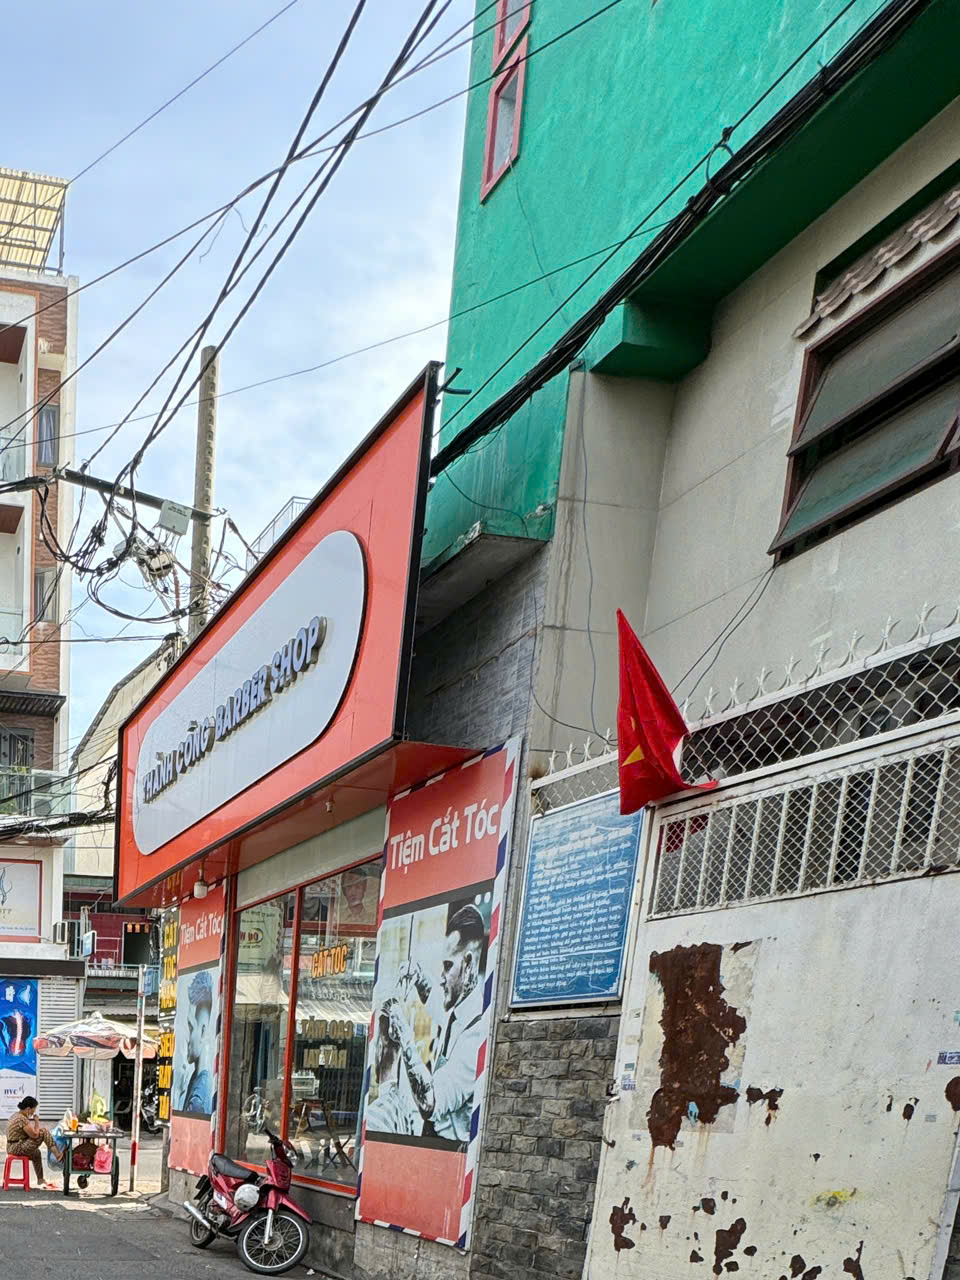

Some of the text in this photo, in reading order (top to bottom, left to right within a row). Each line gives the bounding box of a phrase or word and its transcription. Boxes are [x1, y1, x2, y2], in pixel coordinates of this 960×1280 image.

[215, 665, 272, 741] BARBER
[271, 616, 327, 693] SHOP
[390, 798, 500, 875] Tiệm Cắt Tóc
